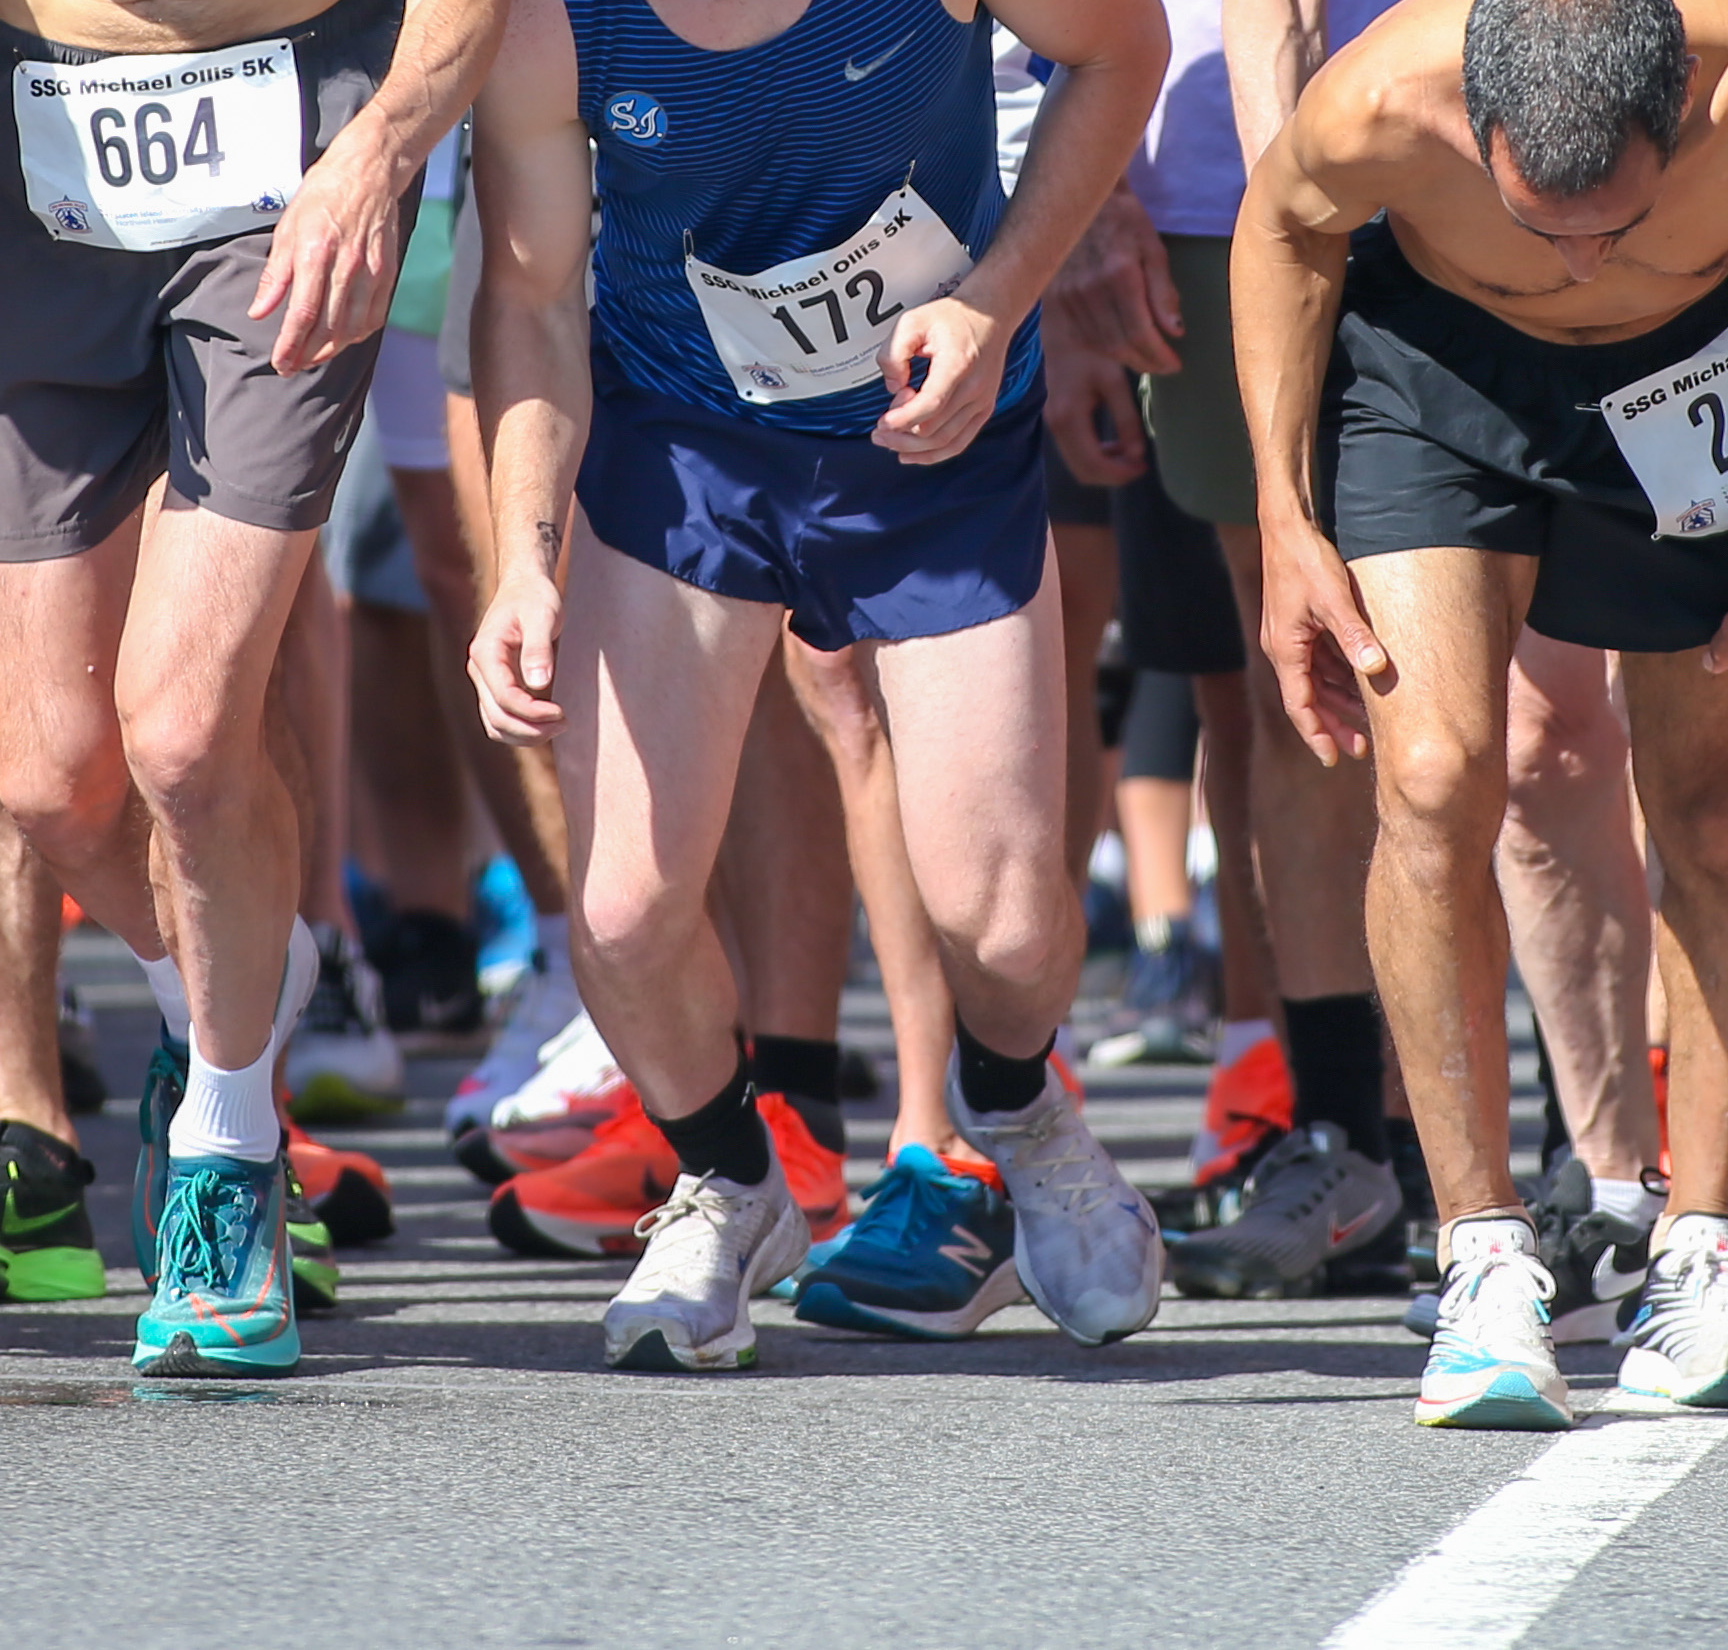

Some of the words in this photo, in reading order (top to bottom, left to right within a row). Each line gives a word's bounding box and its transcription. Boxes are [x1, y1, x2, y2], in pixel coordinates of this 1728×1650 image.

[29, 78, 72, 97] SSG
[78, 74, 173, 96] Michael
[180, 66, 235, 87] Ollis
[241, 55, 278, 77] 5K
[89, 96, 226, 188] 664
[700, 271, 742, 293] SSG
[742, 269, 829, 301] Michael
[832, 238, 882, 274] Ollis
[882, 206, 914, 239] 5K
[771, 268, 906, 356] 172
[1622, 387, 1668, 421] SSG
